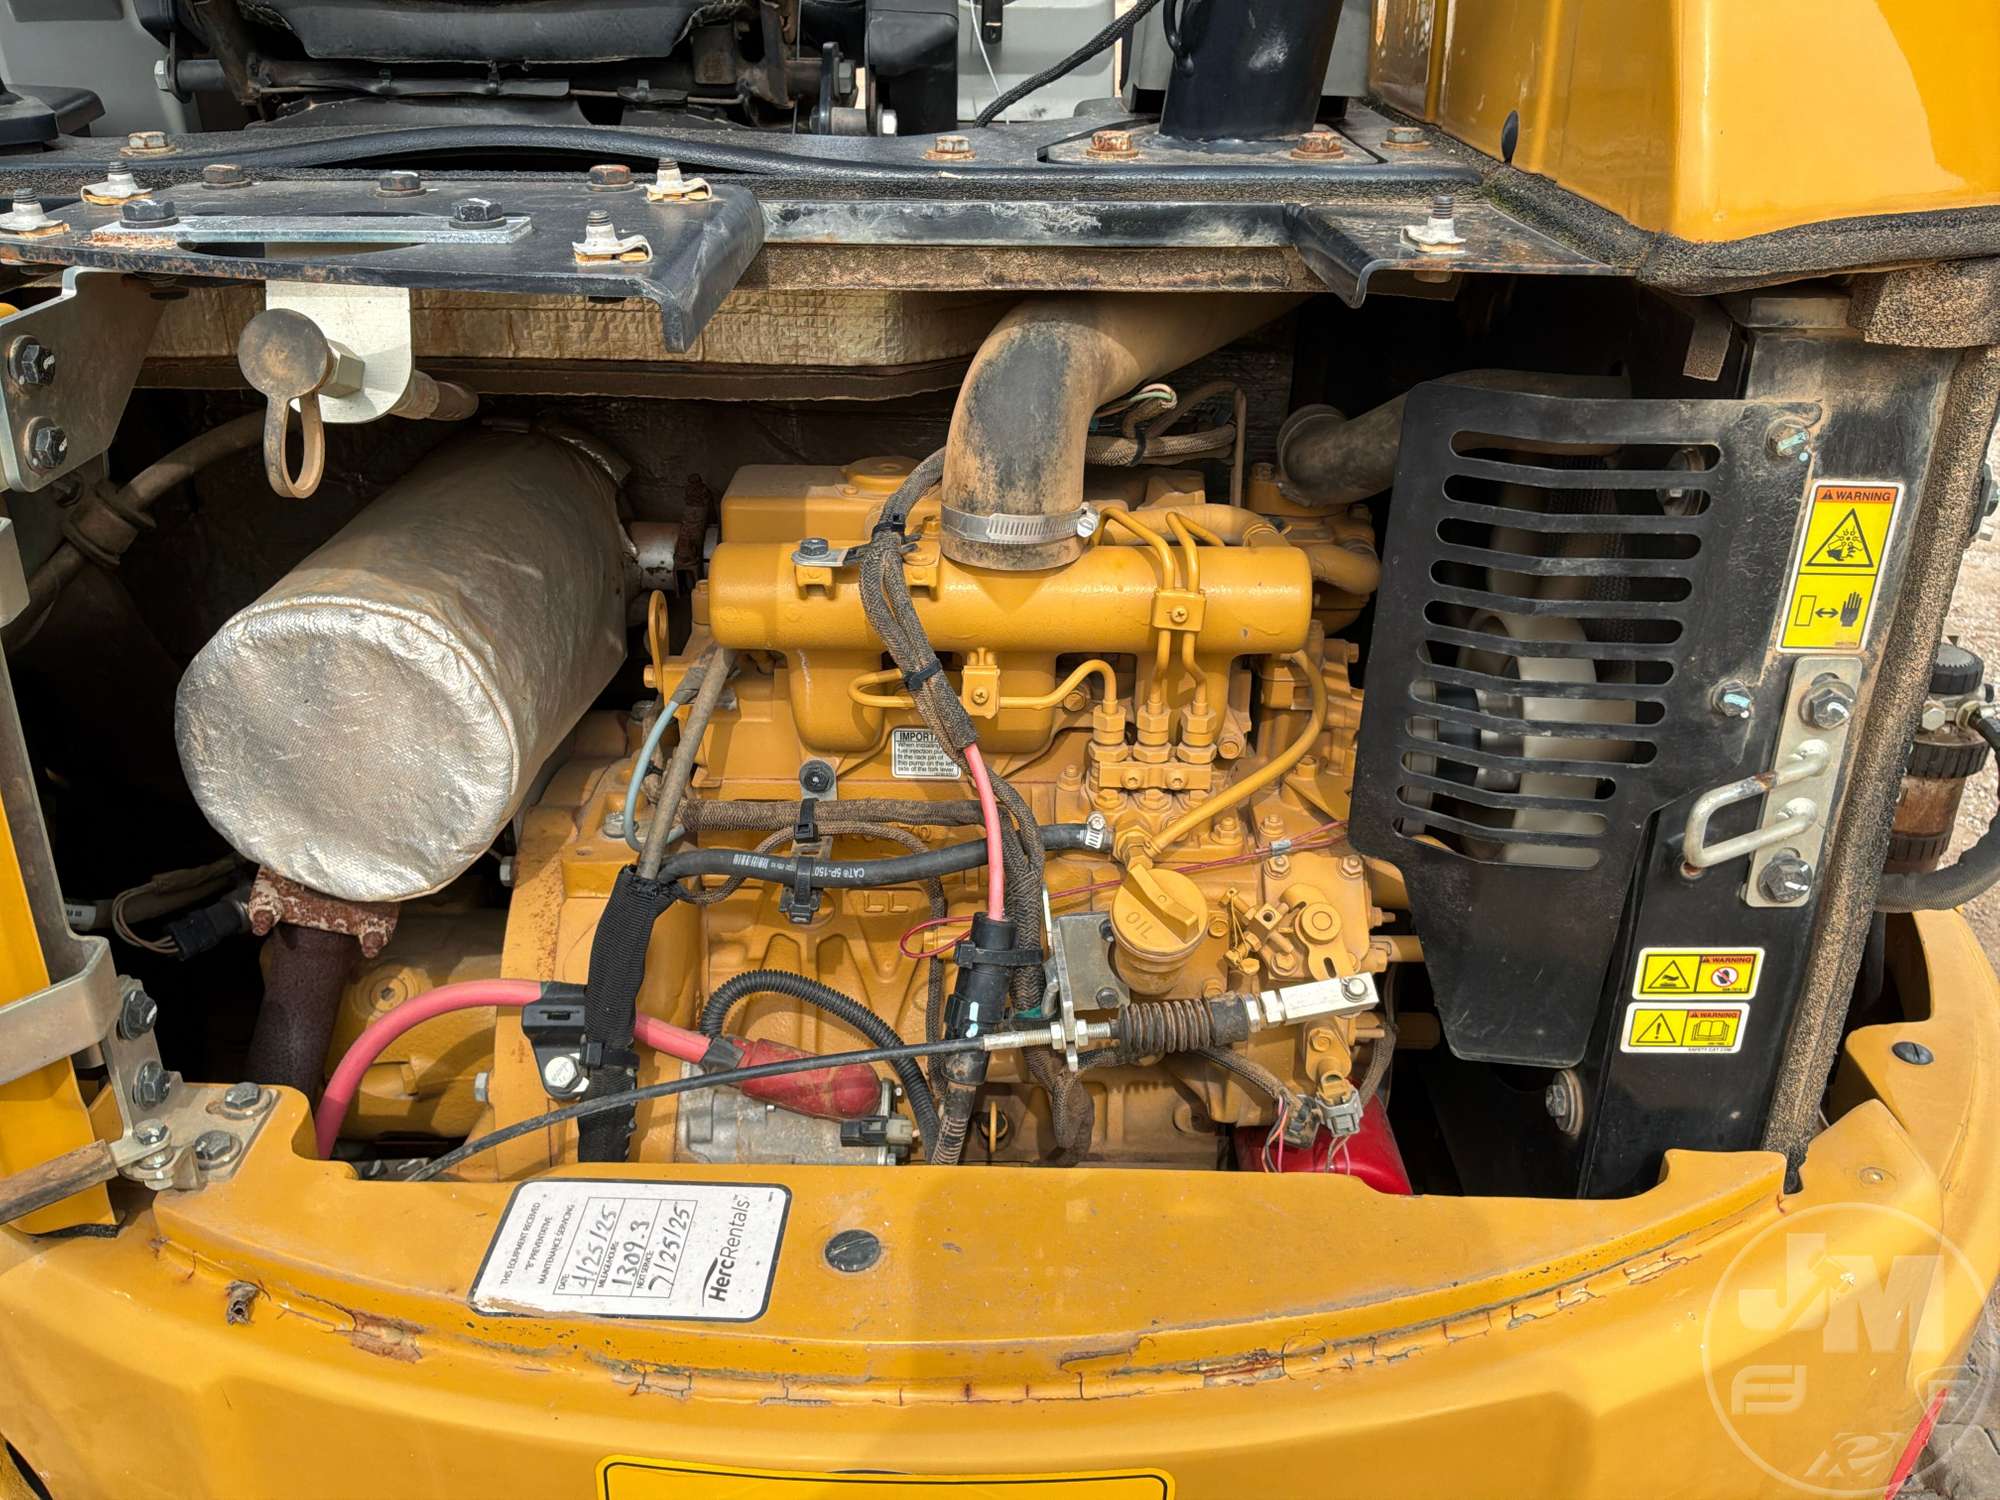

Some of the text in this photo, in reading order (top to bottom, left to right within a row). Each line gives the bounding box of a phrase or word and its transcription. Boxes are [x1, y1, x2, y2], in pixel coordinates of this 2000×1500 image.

[1836, 490, 1890, 501] WARNING
[814, 866, 842, 878] 5P-150
[1127, 912, 1152, 939] OIL
[500, 1202, 541, 1285] THIS EQUIPMENT RECEIVED
[528, 1215, 553, 1260] PREVENTATIVE
[538, 1204, 575, 1284] MAINTENANCE SERVICING
[635, 1273, 646, 1288] NEXT
